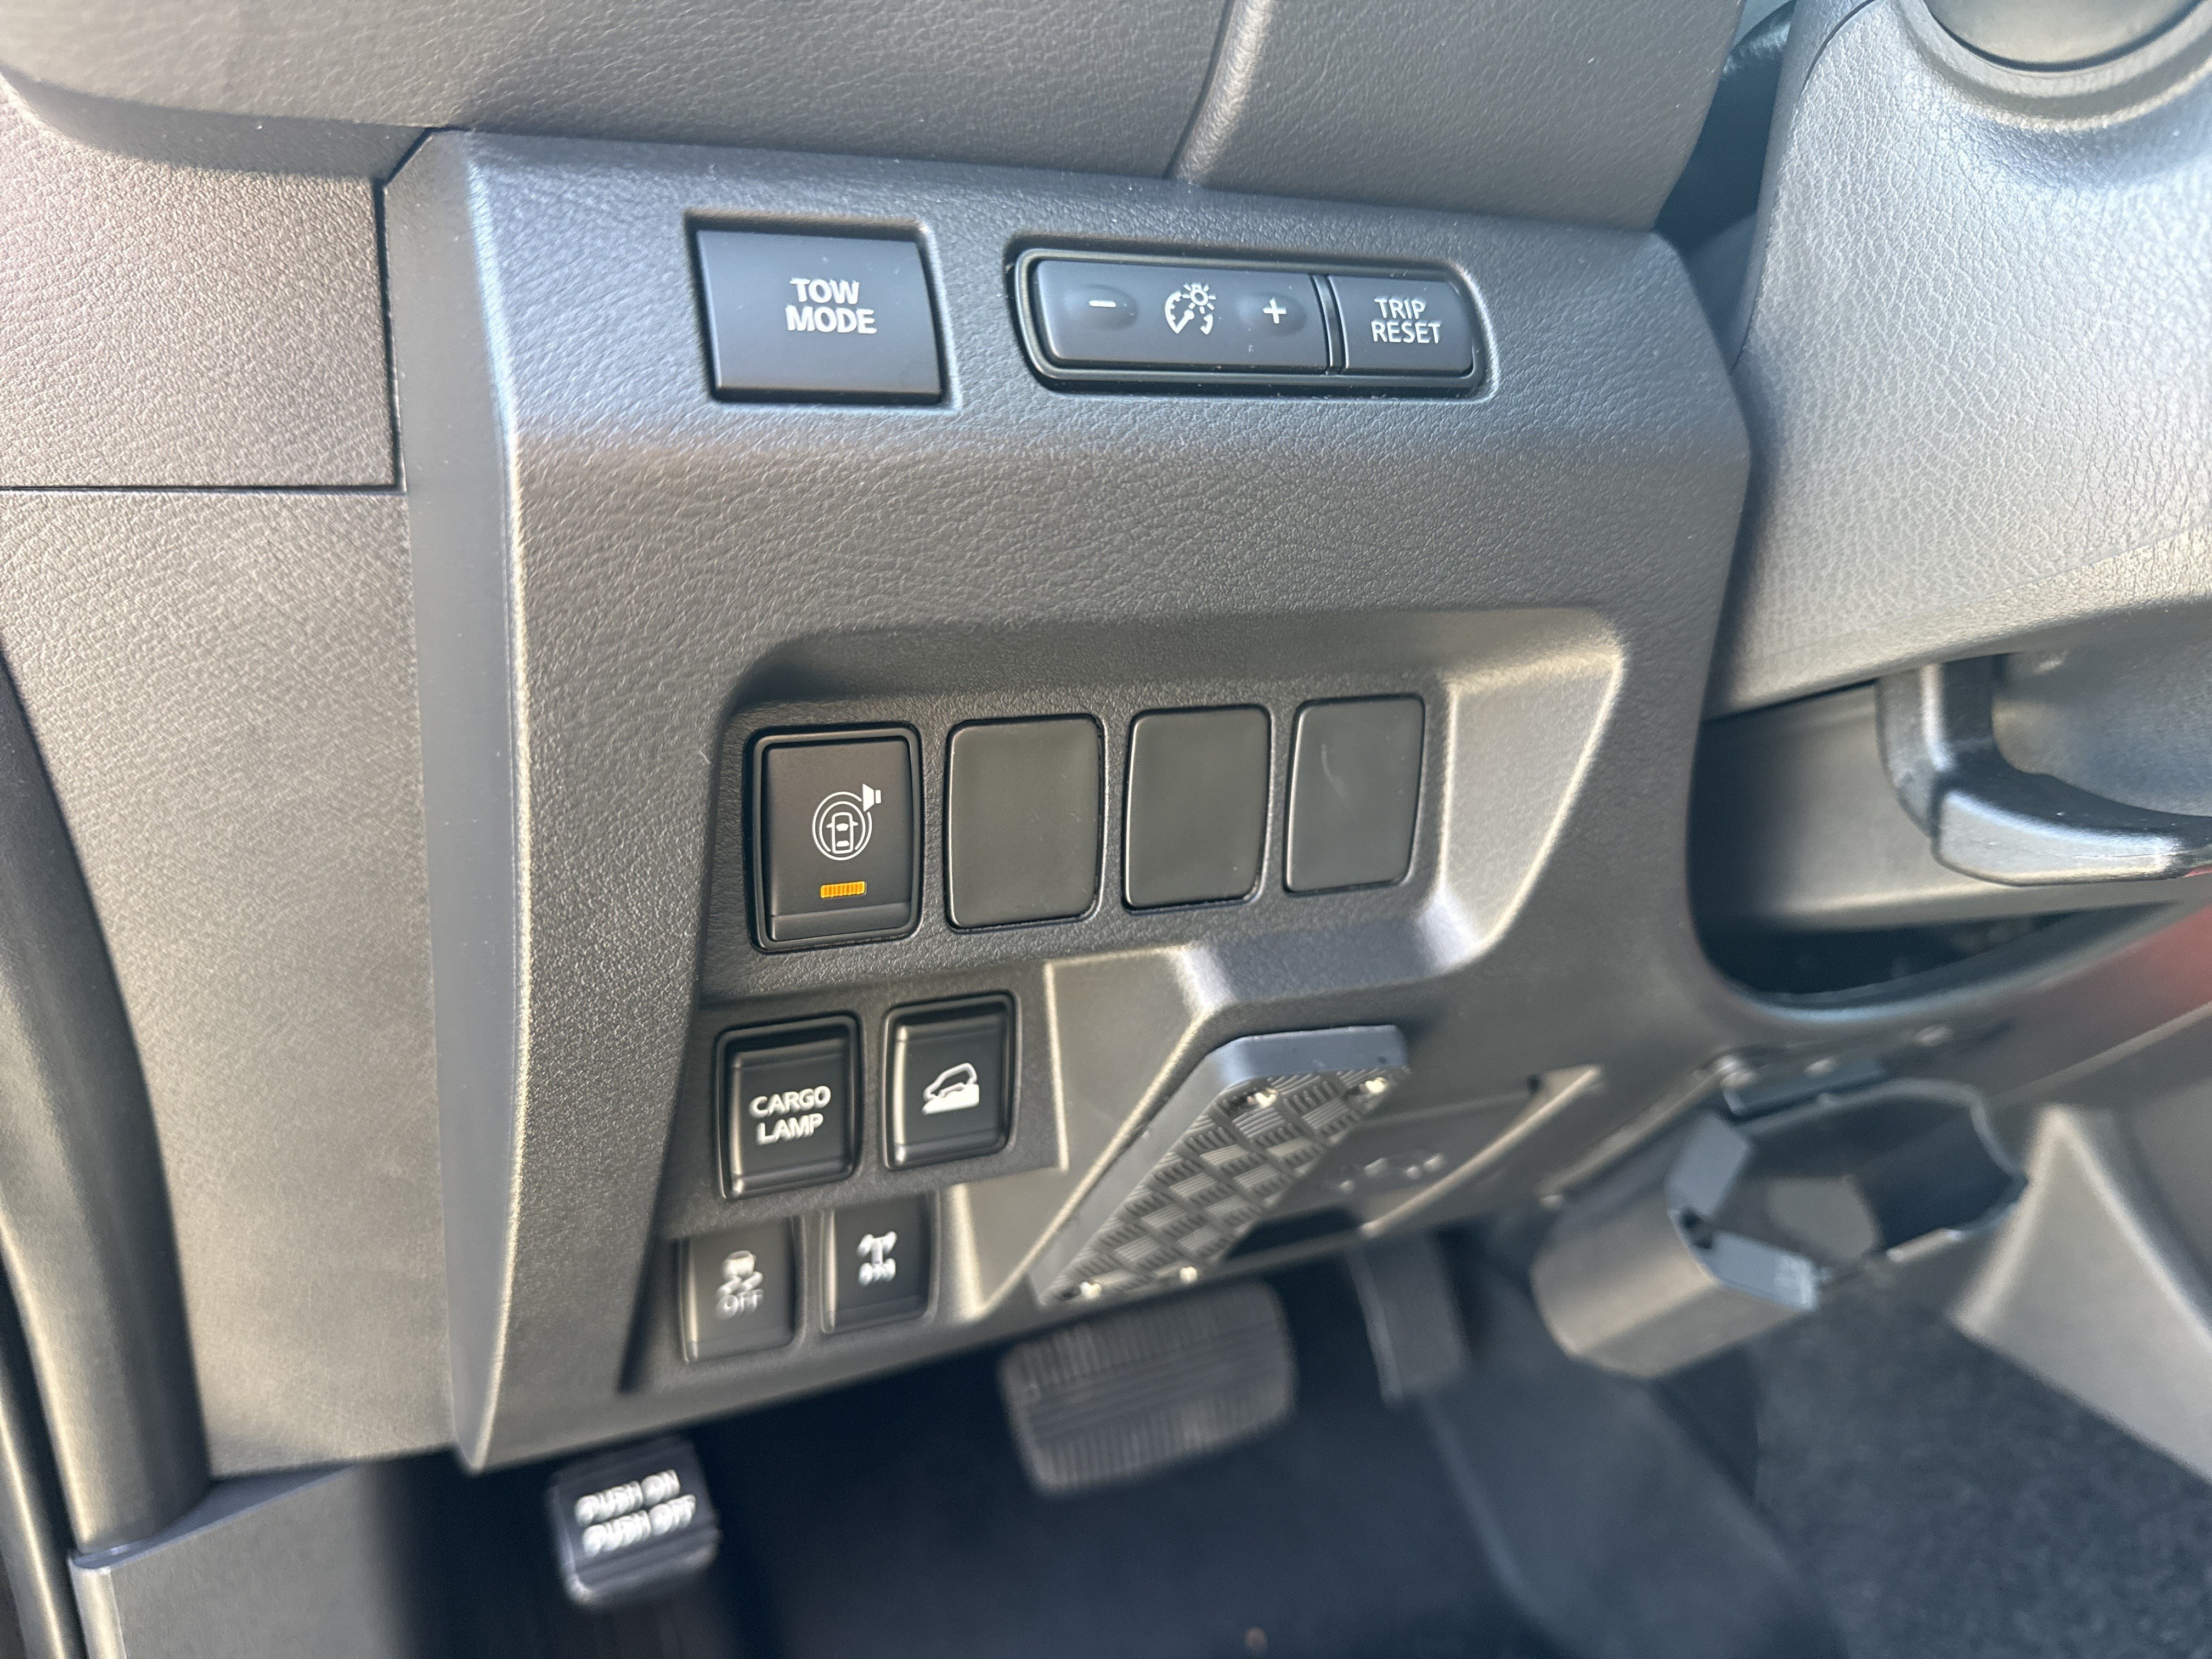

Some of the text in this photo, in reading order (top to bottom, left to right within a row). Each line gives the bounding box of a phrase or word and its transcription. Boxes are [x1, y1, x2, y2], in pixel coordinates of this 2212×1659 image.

[789, 277, 860, 304] TOW
[785, 304, 877, 334] MODE
[1373, 296, 1426, 319] TRIP
[1371, 319, 1441, 344] RESET
[749, 1085, 832, 1118] CARGO
[757, 1113, 824, 1146] LAMP
[716, 1289, 764, 1318] OFF
